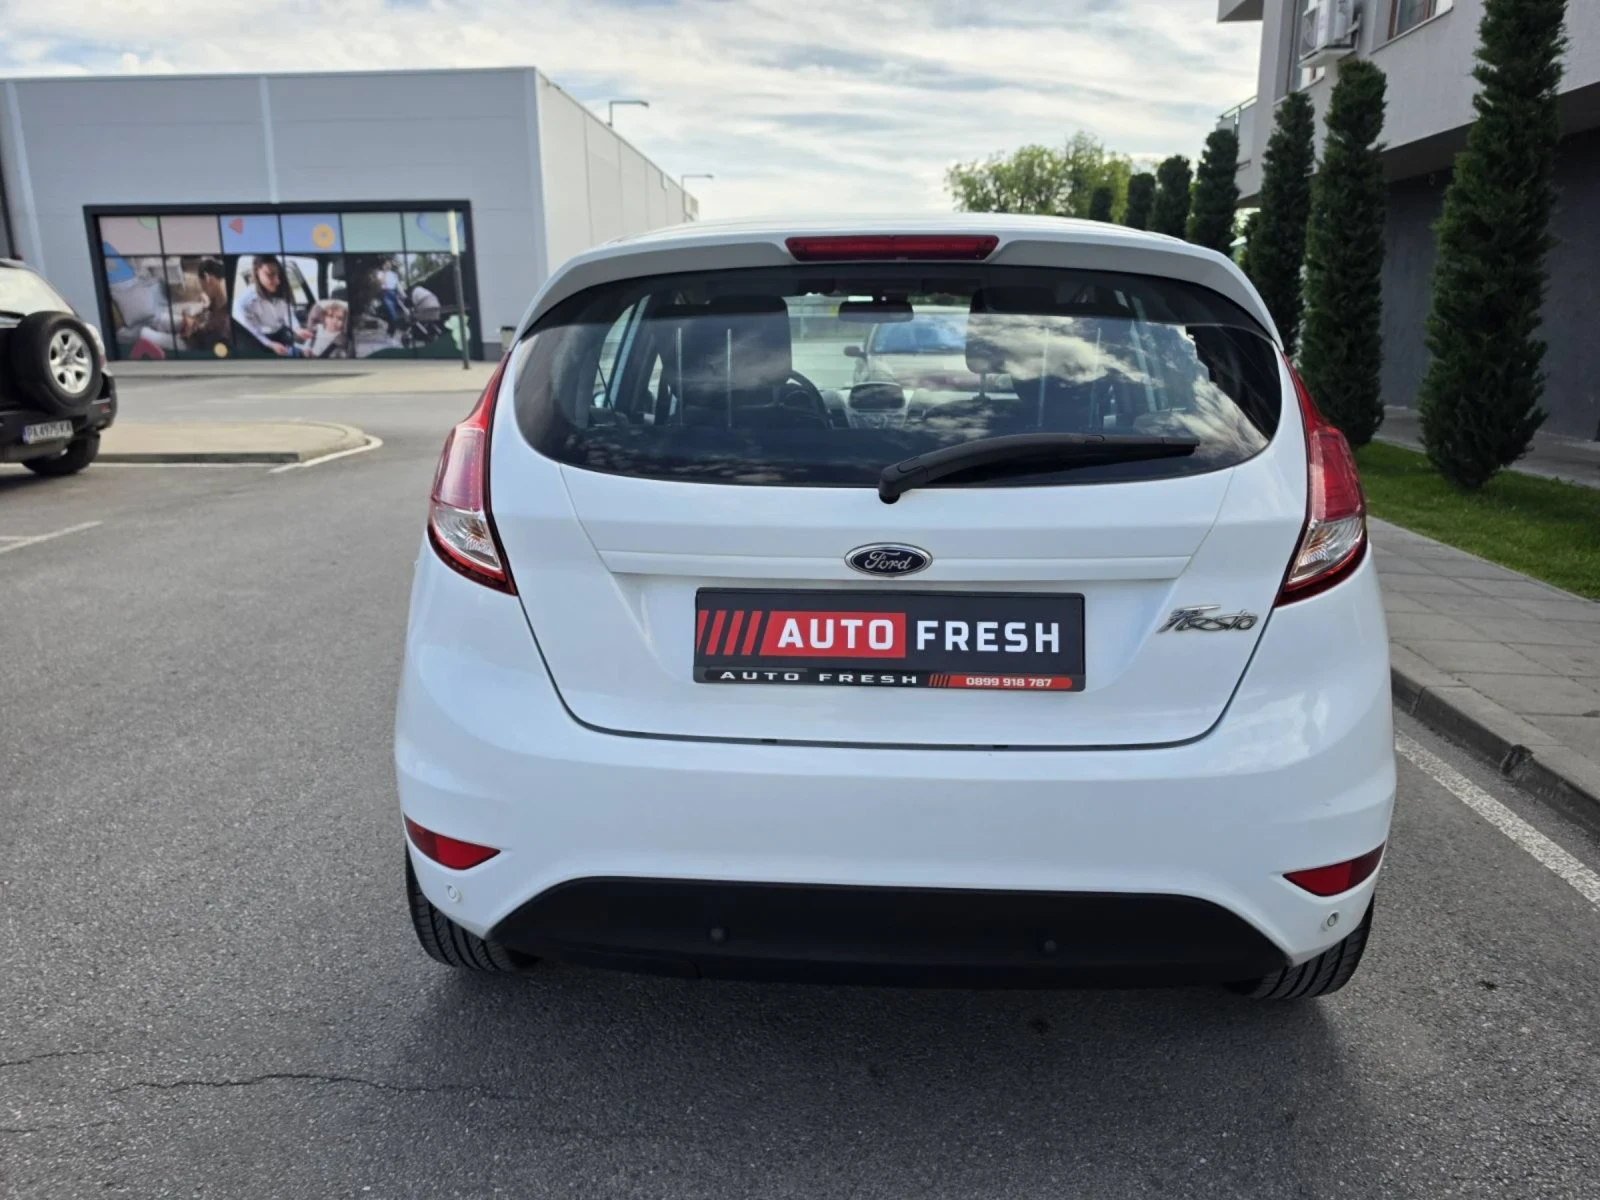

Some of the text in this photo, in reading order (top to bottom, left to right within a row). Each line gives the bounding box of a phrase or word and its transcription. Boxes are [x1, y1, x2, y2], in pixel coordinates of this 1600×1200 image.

[864, 550, 912, 569] Ford
[1156, 604, 1258, 634] Fiesta
[777, 618, 1060, 653] AUTO FRESH
[720, 671, 917, 684] AUTO FRESH
[966, 677, 1052, 687] 0899 918 787
